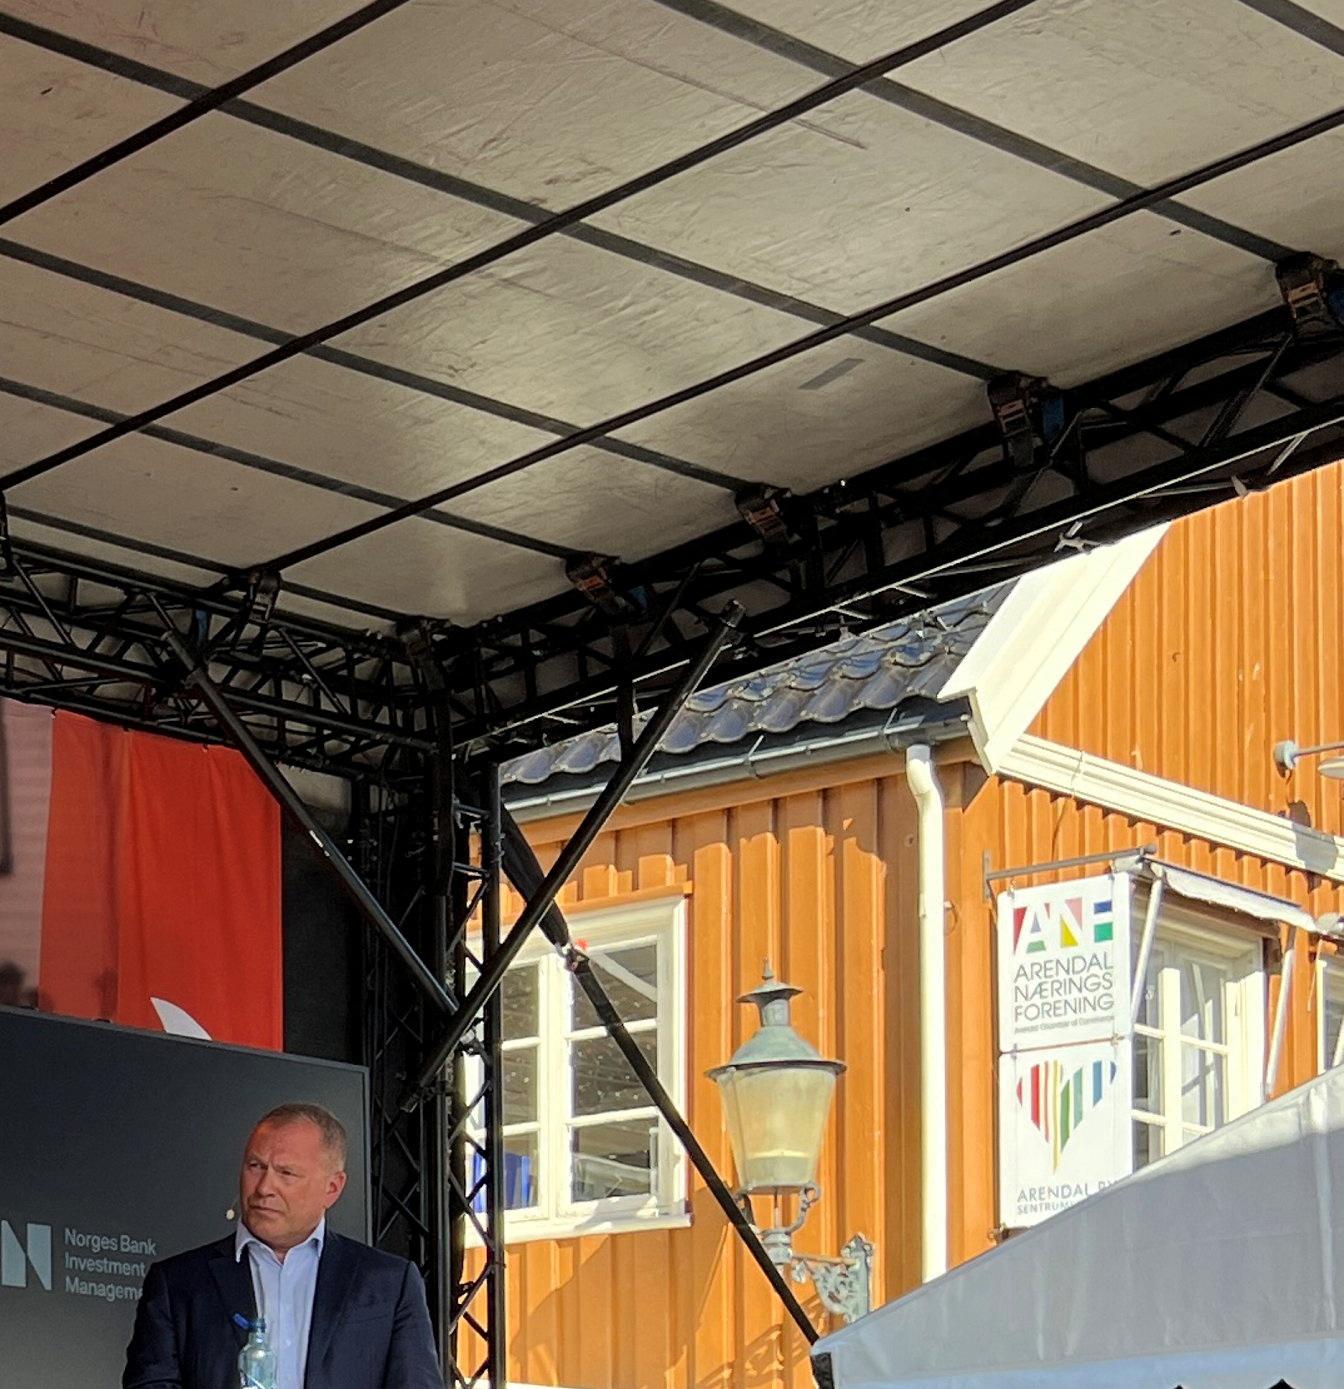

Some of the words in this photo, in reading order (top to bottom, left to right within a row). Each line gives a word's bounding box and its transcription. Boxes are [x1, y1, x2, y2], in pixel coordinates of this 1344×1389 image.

[1013, 951, 1114, 983] ARENDAL
[1014, 972, 1113, 1002] NÆRINGS
[1014, 993, 1114, 1022] FORENING
[1017, 1183, 1089, 1203] ARENDAL
[1017, 1200, 1074, 1215] SENTRUM
[64, 1227, 118, 1253] Norges
[120, 1235, 157, 1257] Bank
[64, 1251, 146, 1278] Investment
[64, 1276, 144, 1302] Managem
